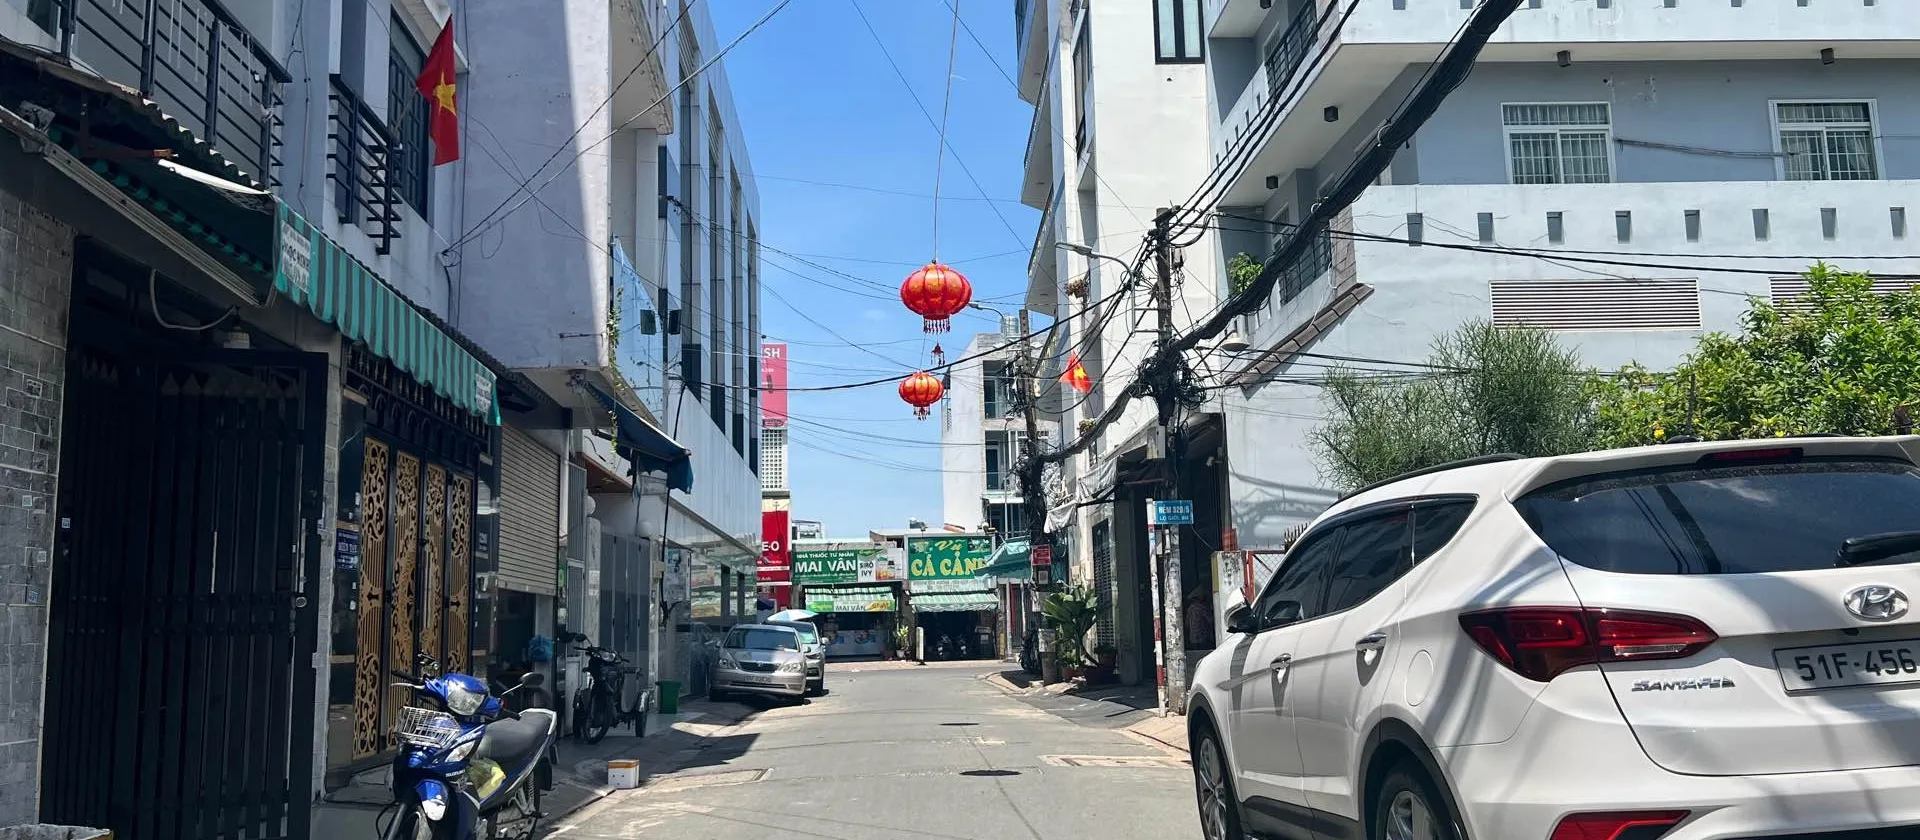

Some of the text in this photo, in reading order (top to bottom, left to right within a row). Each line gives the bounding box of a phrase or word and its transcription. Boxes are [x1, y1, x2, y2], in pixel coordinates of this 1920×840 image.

[809, 551, 828, 559] THUỐC
[795, 558, 857, 573] MAI VÂN
[861, 569, 873, 577] IVY
[850, 603, 866, 611] VÂN
